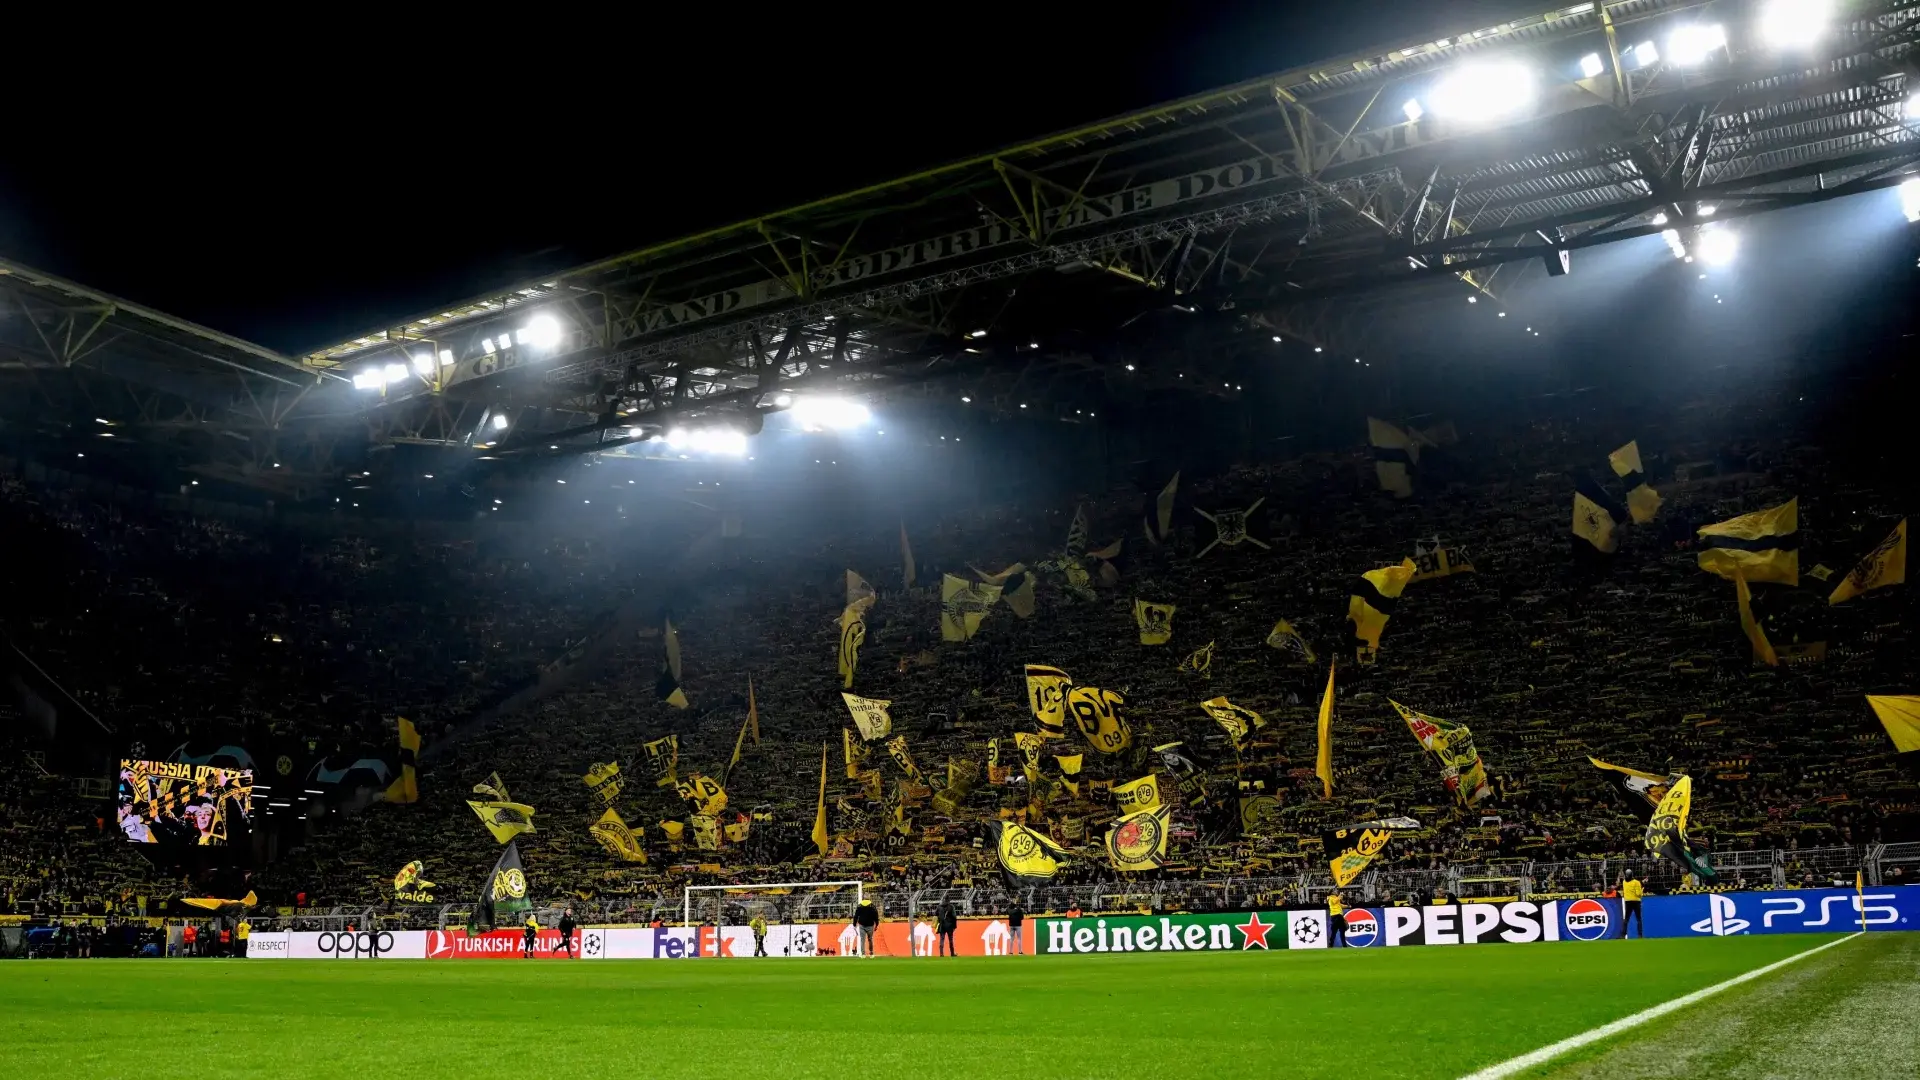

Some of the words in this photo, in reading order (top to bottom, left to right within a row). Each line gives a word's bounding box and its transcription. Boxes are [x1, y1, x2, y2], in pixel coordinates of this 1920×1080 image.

[1103, 731, 1122, 748] 09
[1013, 836, 1031, 850] BVB
[1761, 894, 1899, 928] PS5
[1348, 923, 1376, 933] EPSI
[1384, 900, 1560, 946] PEPSI
[1568, 915, 1606, 925] PEPSI
[1047, 912, 1233, 952] Heineken
[257, 941, 287, 950] RESPECT
[318, 931, 394, 958] oppo
[457, 937, 513, 952] TURKISH
[653, 926, 735, 958] FedEx
